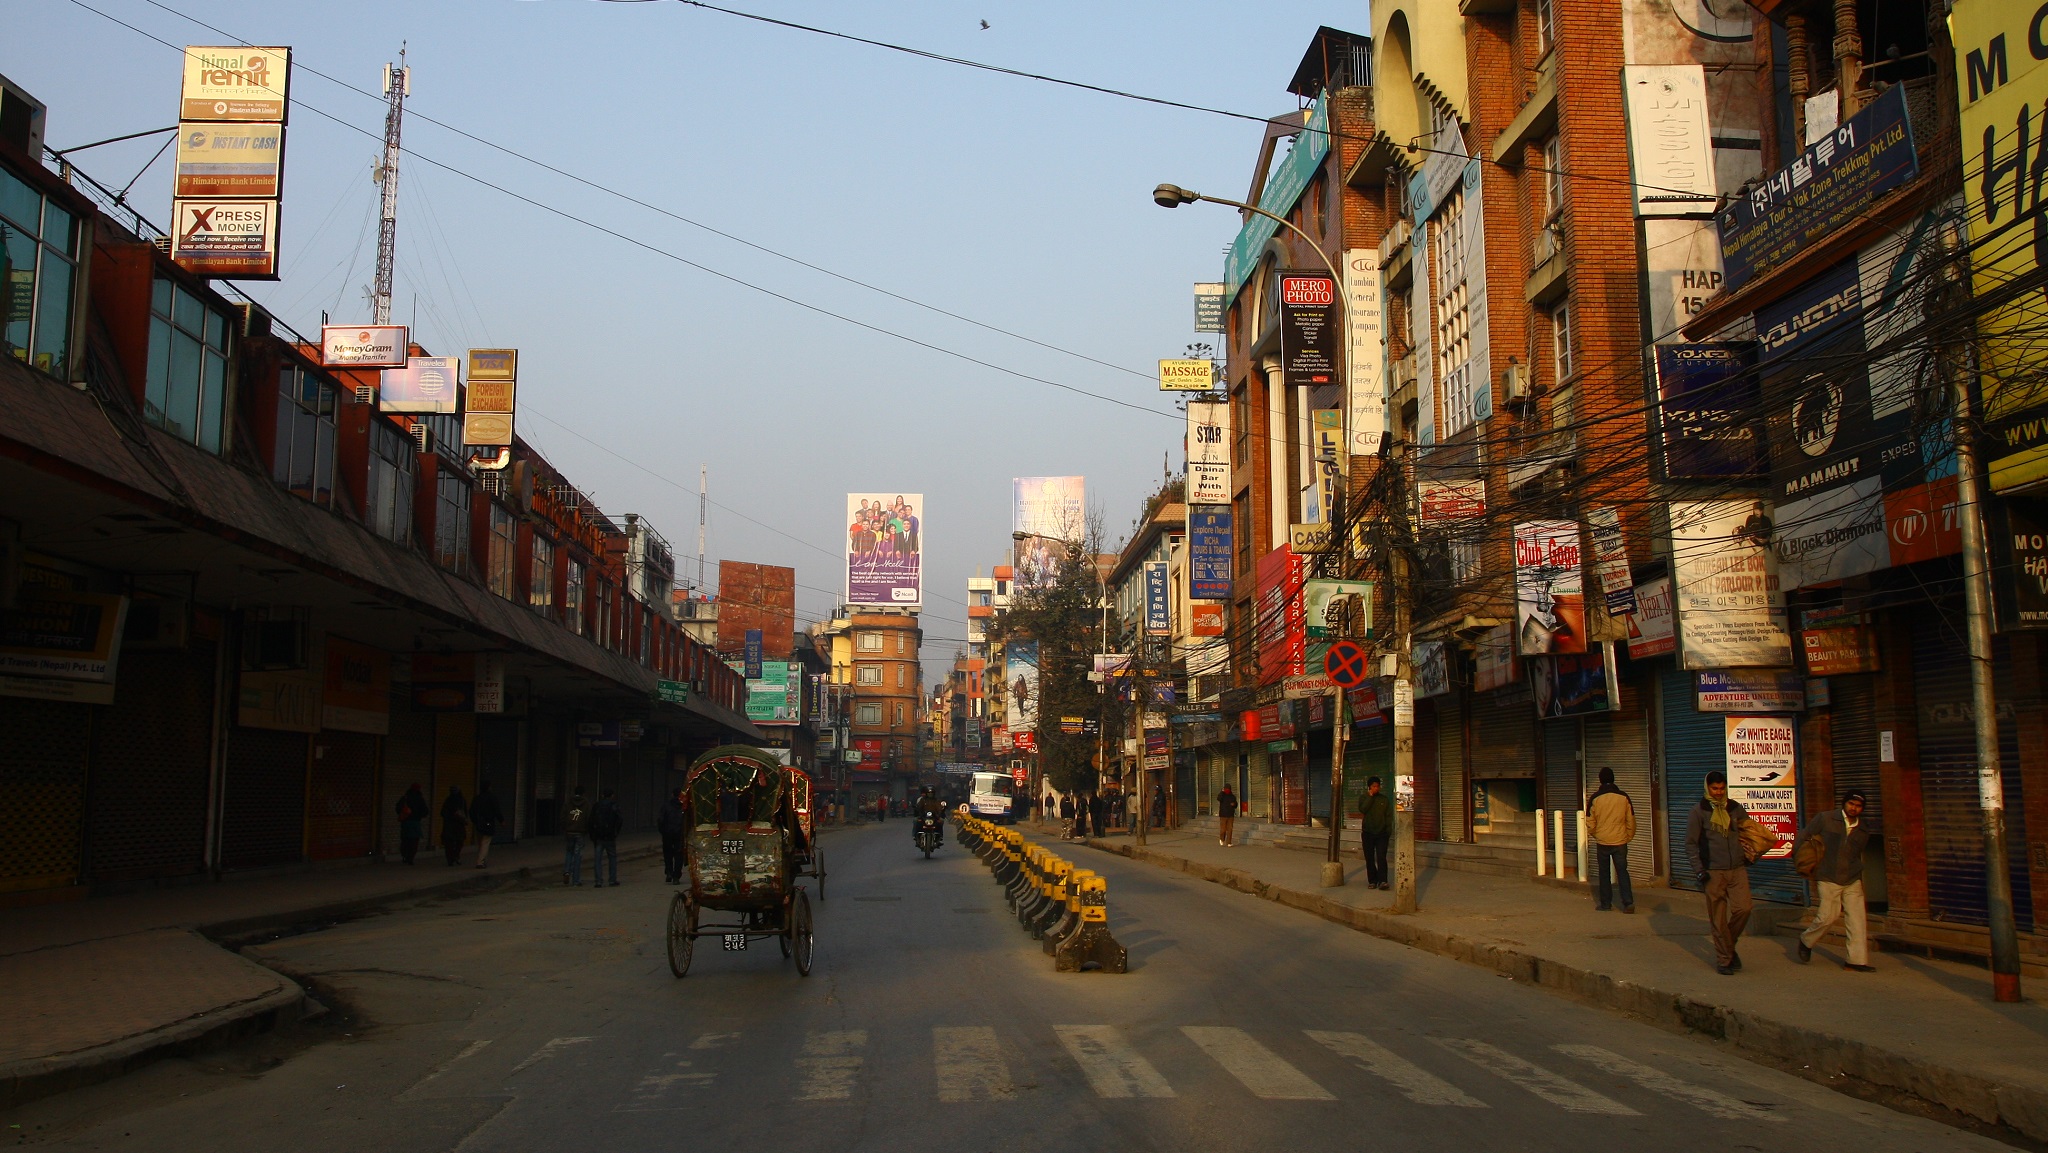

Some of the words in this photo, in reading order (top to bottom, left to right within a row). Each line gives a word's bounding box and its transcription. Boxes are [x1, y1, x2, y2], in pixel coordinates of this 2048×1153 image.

[202, 54, 244, 69] himal
[200, 57, 271, 87] remit
[211, 137, 252, 150] INSTANT
[252, 137, 279, 150] CASH
[192, 177, 230, 187] Himalayan
[230, 177, 249, 186] Bank
[250, 177, 276, 186] Limited
[1722, 234, 1742, 259] Nepal
[1739, 219, 1770, 248] Himalaya
[1769, 202, 1788, 226] Tour
[1787, 201, 1795, 215] &
[1793, 190, 1810, 209] Yak
[1810, 177, 1833, 199] Zone
[1832, 154, 1870, 183] Trekking
[1869, 143, 1887, 160] Pvt.
[1886, 125, 1906, 148] Ltd.
[217, 223, 262, 232] MONEY
[192, 258, 227, 268] Himalayan
[242, 258, 267, 266] Limited
[1290, 280, 1327, 291] MERO
[1351, 275, 1376, 287] Lumbini
[1682, 270, 1726, 291] HAP
[1286, 291, 1331, 302] PHOTO
[1351, 293, 1376, 303] General
[1352, 310, 1381, 318] Insurance
[338, 353, 364, 362] Money
[417, 359, 446, 367] Travelex
[479, 359, 505, 370] VISA
[1162, 366, 1210, 377] MASSAGE
[475, 383, 506, 397] FOREIGN
[471, 398, 508, 411] EXCHANGE
[1196, 426, 1222, 445] STAR
[1881, 440, 1917, 464] EXPED
[1785, 456, 1860, 496] MAMMUT
[1193, 526, 1214, 537] Explore
[1214, 526, 1231, 537] Nepal
[1789, 531, 1823, 555] Black
[1824, 518, 1883, 548] Diamond
[1204, 536, 1220, 546] RICHA
[1193, 545, 1208, 555] TOURS
[1213, 545, 1231, 555] TRAVEL
[1516, 537, 1543, 567] Club
[1548, 537, 1578, 571] Gogo
[1694, 556, 1728, 575] KOREAN
[1730, 553, 1746, 572] LEE
[1679, 574, 1714, 597] BEAUTY
[1715, 575, 1753, 594] PARLOUR
[1690, 597, 1711, 608] 한국
[1744, 594, 1776, 605] 미용실
[1807, 650, 1838, 663] BEAUTY
[1839, 647, 1875, 660] PARLOUR
[8, 657, 38, 668] Travels
[40, 660, 71, 674] (Nepal)
[72, 663, 88, 672] Pvt.
[90, 665, 106, 674] Ltd
[1297, 680, 1315, 690] MONEY
[1700, 672, 1718, 685] Blue
[1719, 674, 1755, 686] Mountain
[1702, 693, 1750, 702] ADVENTURE
[1752, 692, 1780, 701] UNITED
[1746, 728, 1769, 741] WHITE
[1769, 728, 1791, 741] EAGLE
[1728, 742, 1751, 755] TRAVELS
[1751, 743, 1756, 755] &
[1756, 742, 1773, 755] TOURS
[1781, 742, 1793, 755] LTD.
[1746, 790, 1775, 800] HIMALAYAN
[1775, 790, 1793, 800] QUEST
[1759, 814, 1792, 824] TICKETING,
